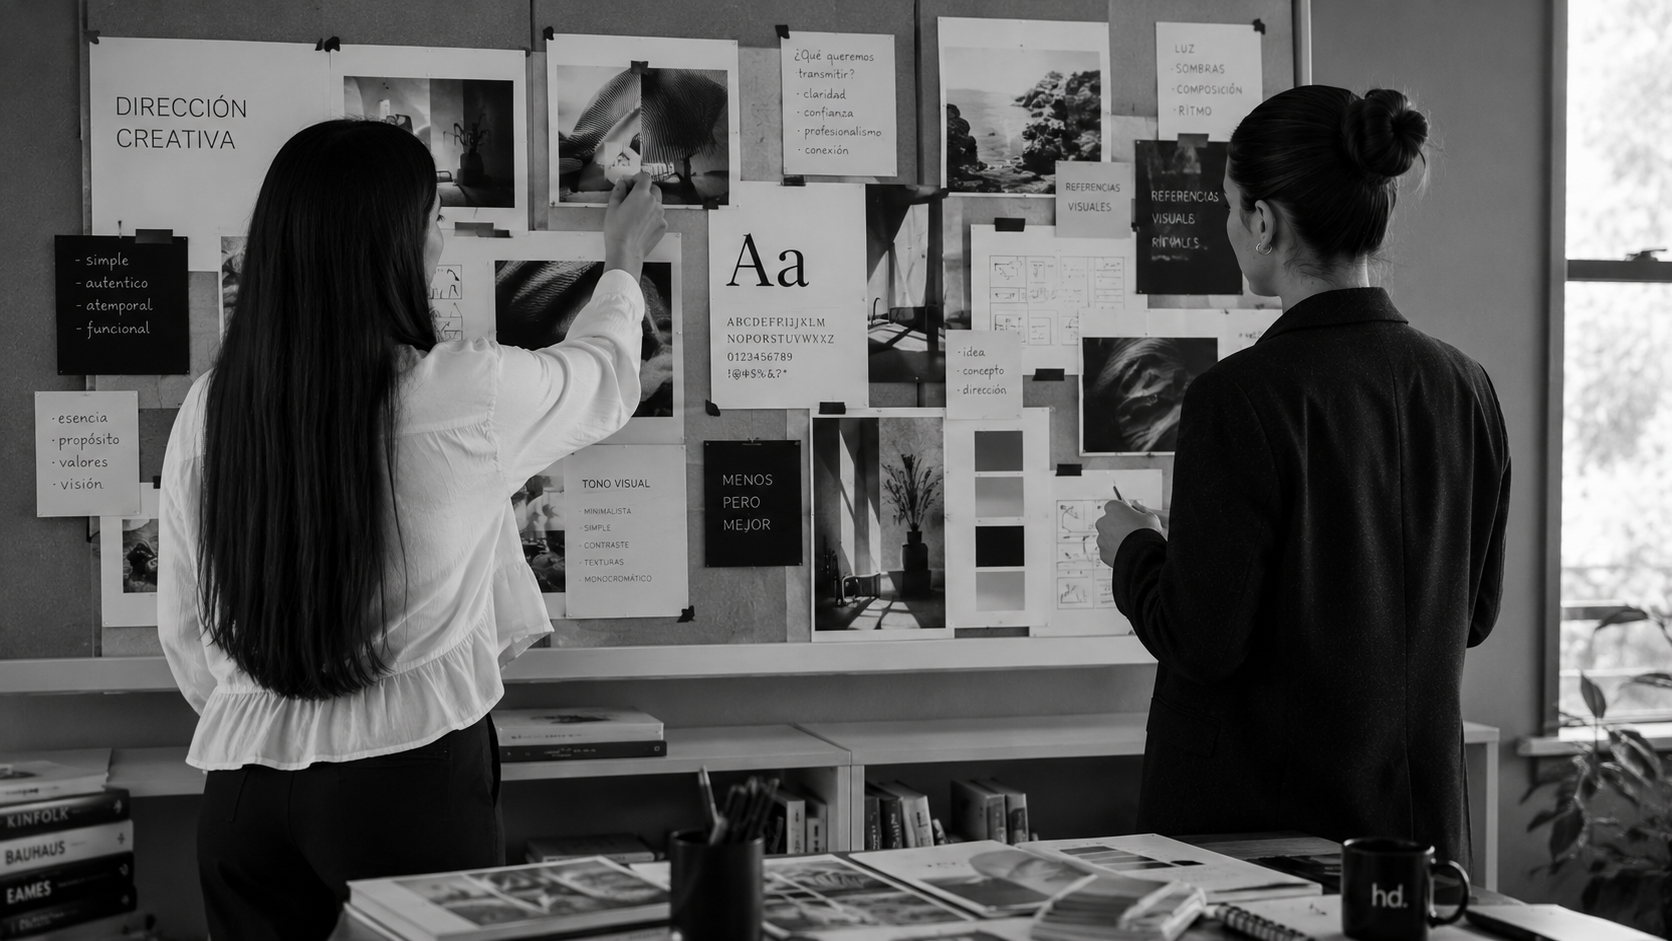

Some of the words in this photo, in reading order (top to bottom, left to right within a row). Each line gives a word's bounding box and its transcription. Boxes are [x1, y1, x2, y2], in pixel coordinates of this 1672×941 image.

[1175, 44, 1194, 53] LUZ
[794, 49, 821, 63] ¿Qué
[827, 54, 874, 66] queremos
[799, 68, 854, 79] transmitir?
[1176, 63, 1224, 74] SOMBRAS
[804, 88, 846, 99] claridad
[1177, 83, 1242, 94] COMPOSICIÓN
[117, 95, 246, 118] DIRECCIÓN
[1179, 105, 1212, 116] RITMO
[804, 106, 853, 120] confianza
[805, 125, 881, 140] profesionalismo
[117, 129, 235, 149] CREATIVA
[805, 145, 848, 154] conexión
[1066, 182, 1120, 192] REFERENCIAS
[1068, 202, 1111, 212] VISUALES
[87, 252, 128, 271] simple
[726, 233, 809, 287] Aa
[86, 276, 148, 288] autentico
[87, 298, 153, 315] atemporal
[87, 320, 150, 339] funcional
[727, 352, 792, 361] 0123456789
[964, 346, 985, 357] idea
[963, 365, 1004, 379] concepto
[963, 384, 1006, 394] dirección
[59, 412, 108, 424] esencia
[59, 433, 119, 451] propósito
[59, 455, 108, 467] valores
[61, 478, 103, 490] visión
[582, 479, 611, 488] TONO
[615, 479, 650, 488] VISUAL
[723, 474, 772, 485] MENOS
[724, 496, 760, 508] PERO
[724, 519, 770, 533] MEJOR
[584, 540, 629, 549] CONTRASTE
[585, 574, 652, 583] MONOCROMÁTICO
[7, 807, 69, 828] KINFOLK
[5, 840, 66, 865] BAUHAUS
[7, 880, 51, 904] EAMES
[1372, 883, 1407, 908] hd.
